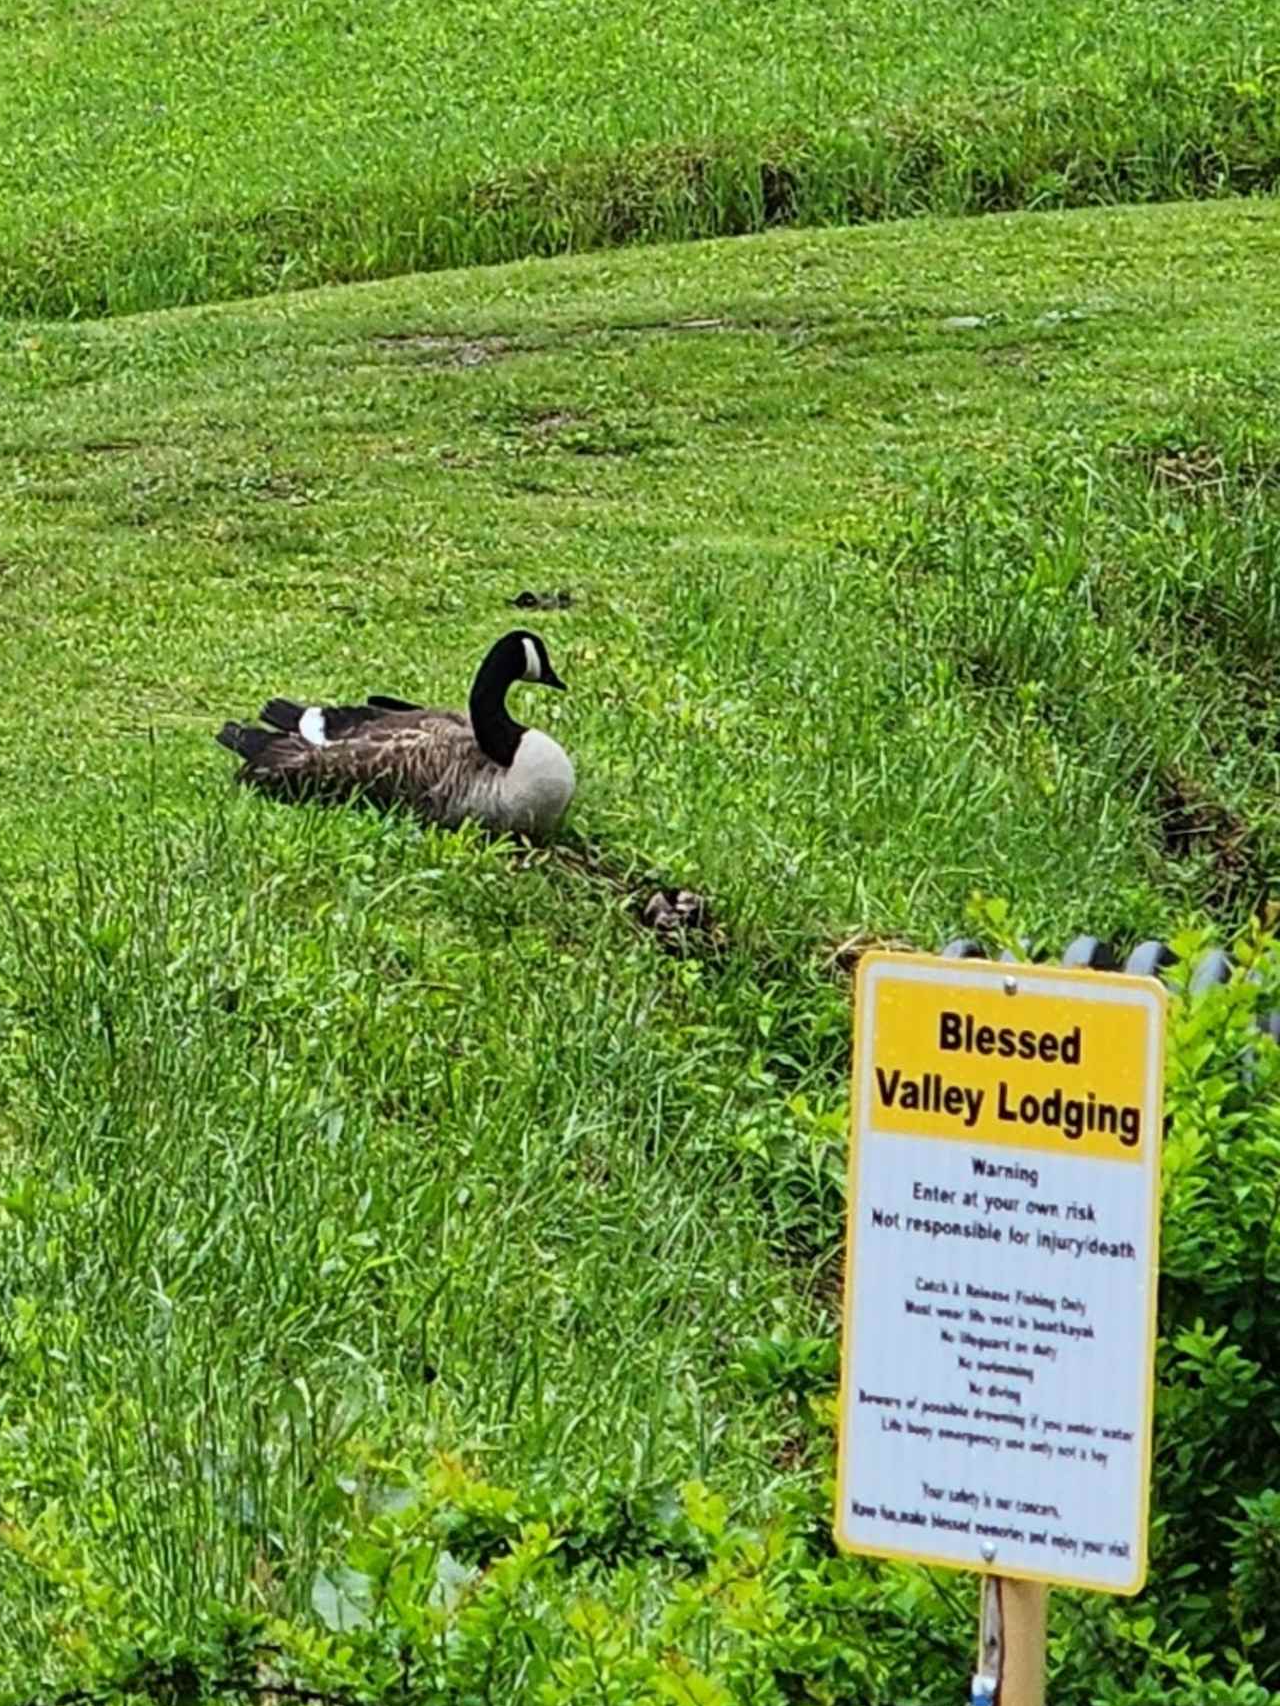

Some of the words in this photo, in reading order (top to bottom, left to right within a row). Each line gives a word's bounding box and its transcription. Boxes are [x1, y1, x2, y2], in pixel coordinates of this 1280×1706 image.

[940, 1012, 1081, 1065] Blessed
[875, 1067, 984, 1127] Valley
[998, 1082, 1140, 1147] Lodging
[972, 1157, 1038, 1188] Warning
[913, 1182, 956, 1204] Enter
[963, 1192, 978, 1208] at
[984, 1195, 1020, 1215] your
[1026, 1200, 1058, 1216] own
[1066, 1202, 1096, 1223] risk
[872, 1208, 900, 1230] Not
[906, 1217, 1001, 1242] responsible
[1009, 1225, 1030, 1245] for
[915, 1276, 948, 1294] Catch
[1015, 1290, 1056, 1313] Fishing
